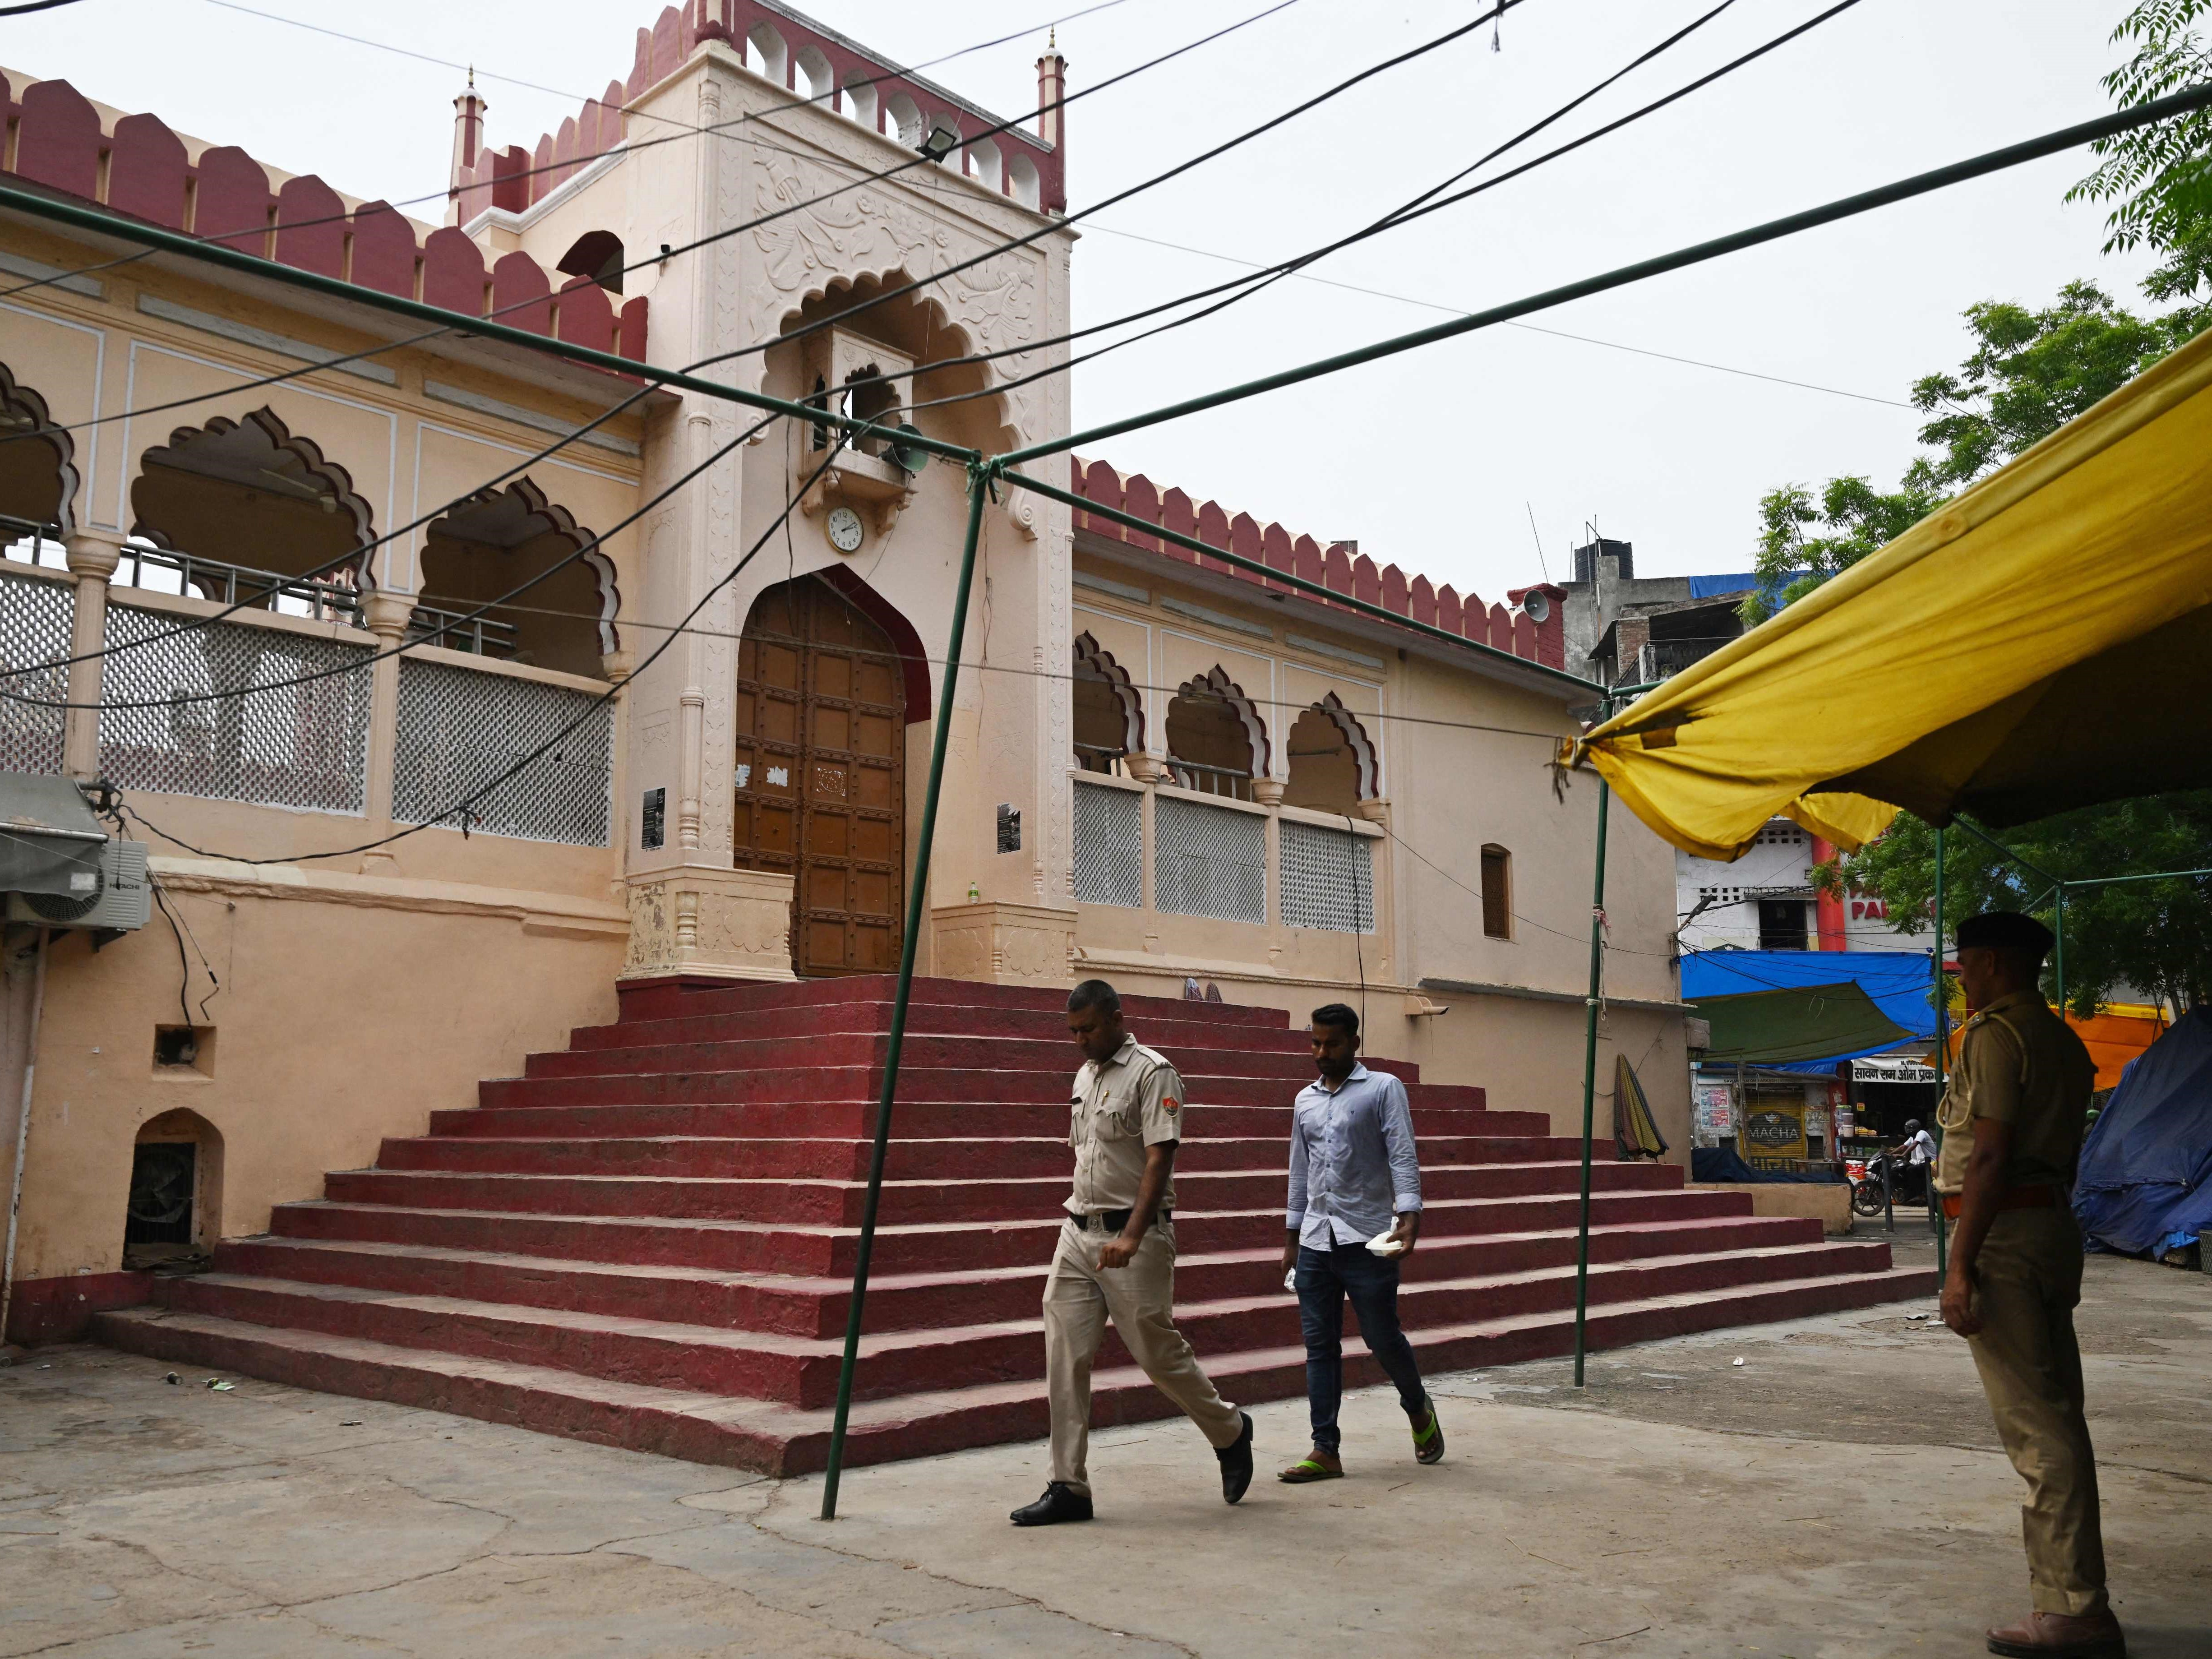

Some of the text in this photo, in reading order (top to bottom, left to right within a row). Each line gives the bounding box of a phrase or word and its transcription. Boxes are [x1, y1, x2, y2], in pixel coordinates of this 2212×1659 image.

[1854, 1067, 1879, 1080] सावन
[1880, 1069, 1896, 1080] राम
[1898, 1066, 1916, 1080] ओम
[1748, 1127, 1799, 1138] MACHA
